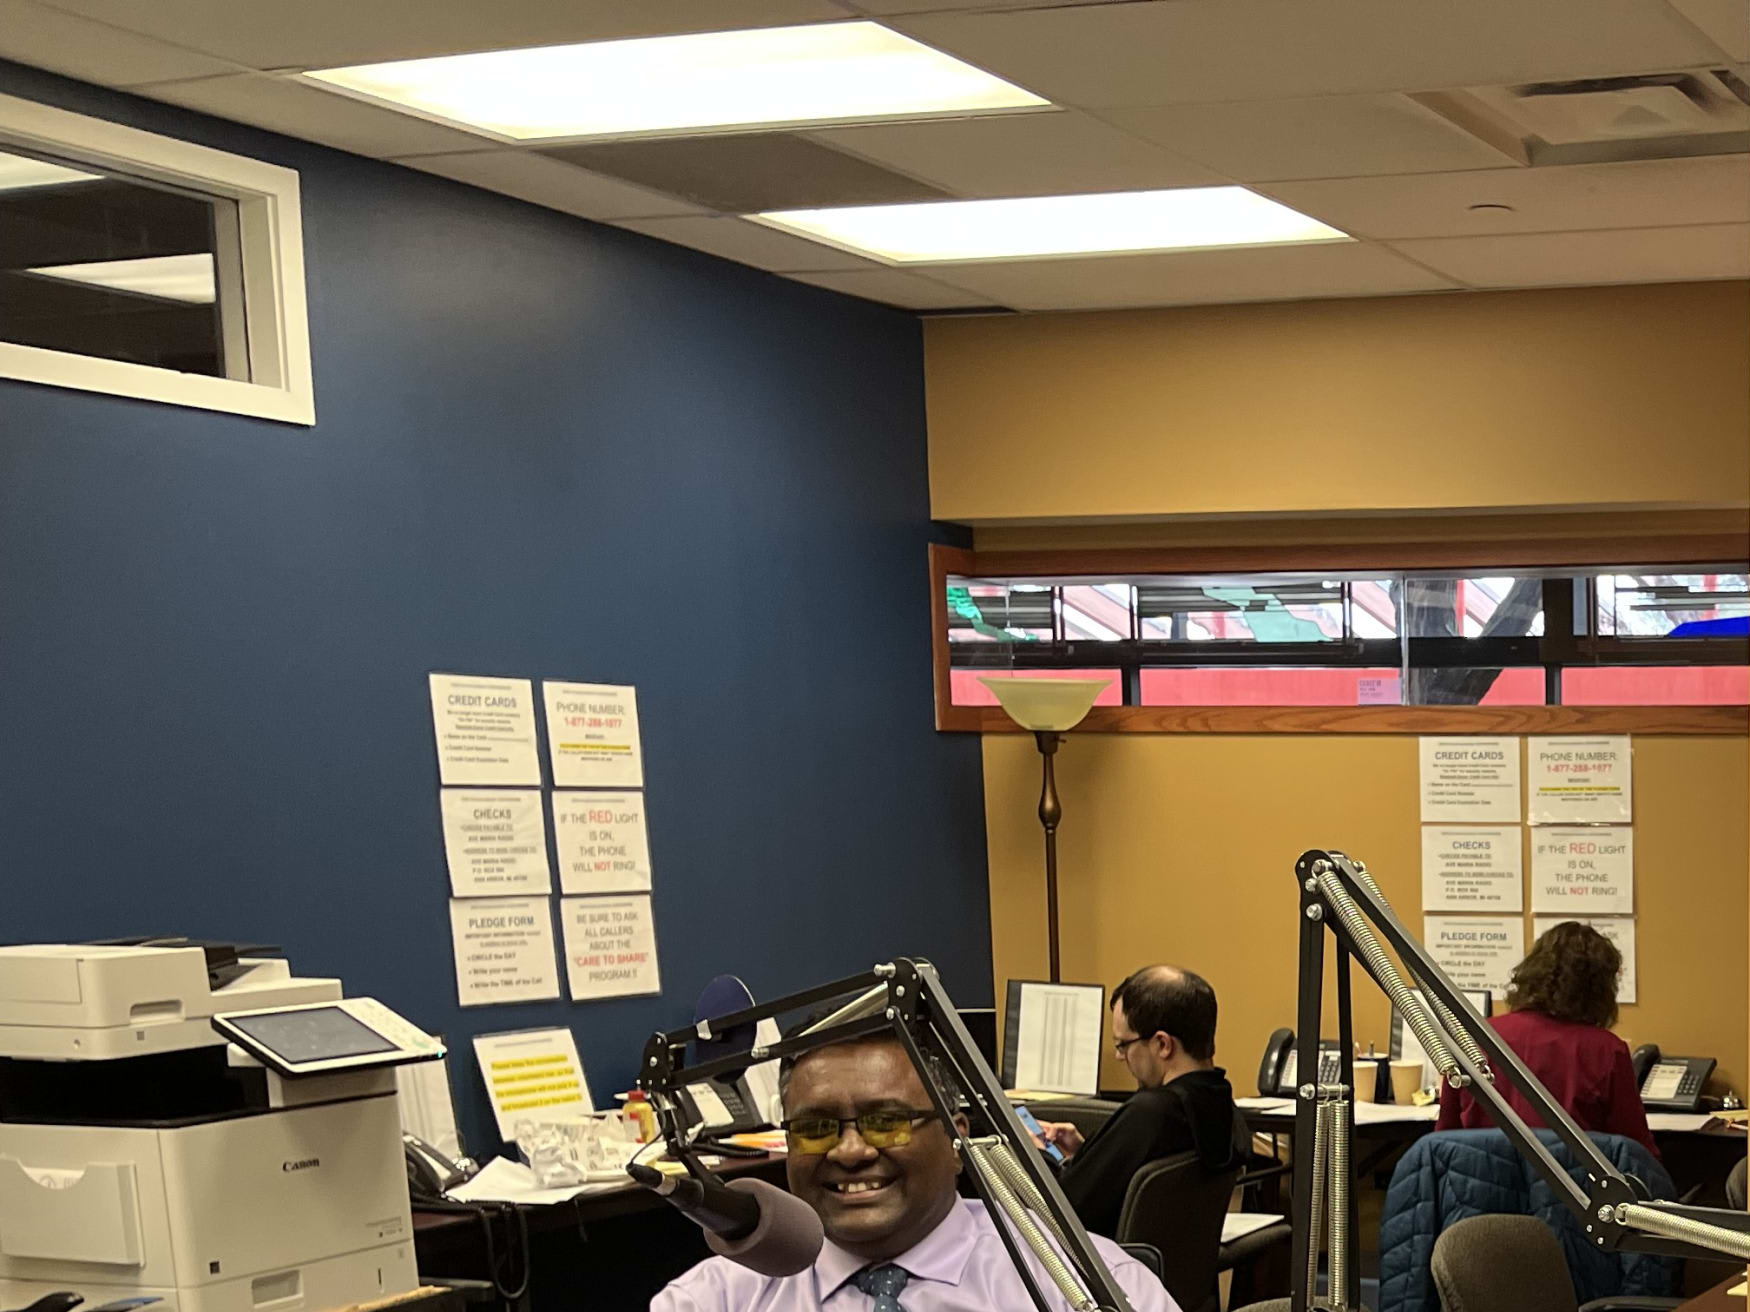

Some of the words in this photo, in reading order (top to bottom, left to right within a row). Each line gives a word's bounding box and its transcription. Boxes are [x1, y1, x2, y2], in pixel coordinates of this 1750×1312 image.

[447, 694, 482, 707] CREDIT
[484, 696, 517, 708] CARDS
[556, 702, 586, 713] PHONE
[1435, 751, 1469, 761] CREDIT
[1471, 751, 1504, 761] CARDS
[1540, 752, 1573, 761] PHONE
[473, 808, 512, 820] CHECKS
[560, 812, 567, 824] IF
[569, 812, 587, 824] THE
[588, 810, 613, 824] RED
[615, 812, 638, 824] LIGHT
[589, 831, 597, 841] IS
[1452, 841, 1491, 850] CHECKS
[1538, 845, 1546, 854] IF
[1548, 845, 1567, 854] THE
[1569, 843, 1597, 854] RED
[1599, 845, 1626, 854] LIGHT
[579, 846, 596, 857] THE
[598, 846, 626, 857] PHONE
[573, 861, 592, 873] WILL
[594, 861, 611, 872] NOT
[1567, 860, 1577, 869] IS
[1555, 874, 1573, 882] THE
[1575, 874, 1608, 882] PHONE
[1545, 887, 1568, 896] WILL
[1570, 887, 1589, 896] NOT
[468, 916, 505, 928] PLEDGE
[507, 916, 534, 927] FORM
[1440, 932, 1478, 942] PLEDGE
[1480, 932, 1507, 942] FORM
[603, 954, 615, 964] TO
[282, 1158, 320, 1172] Canon
